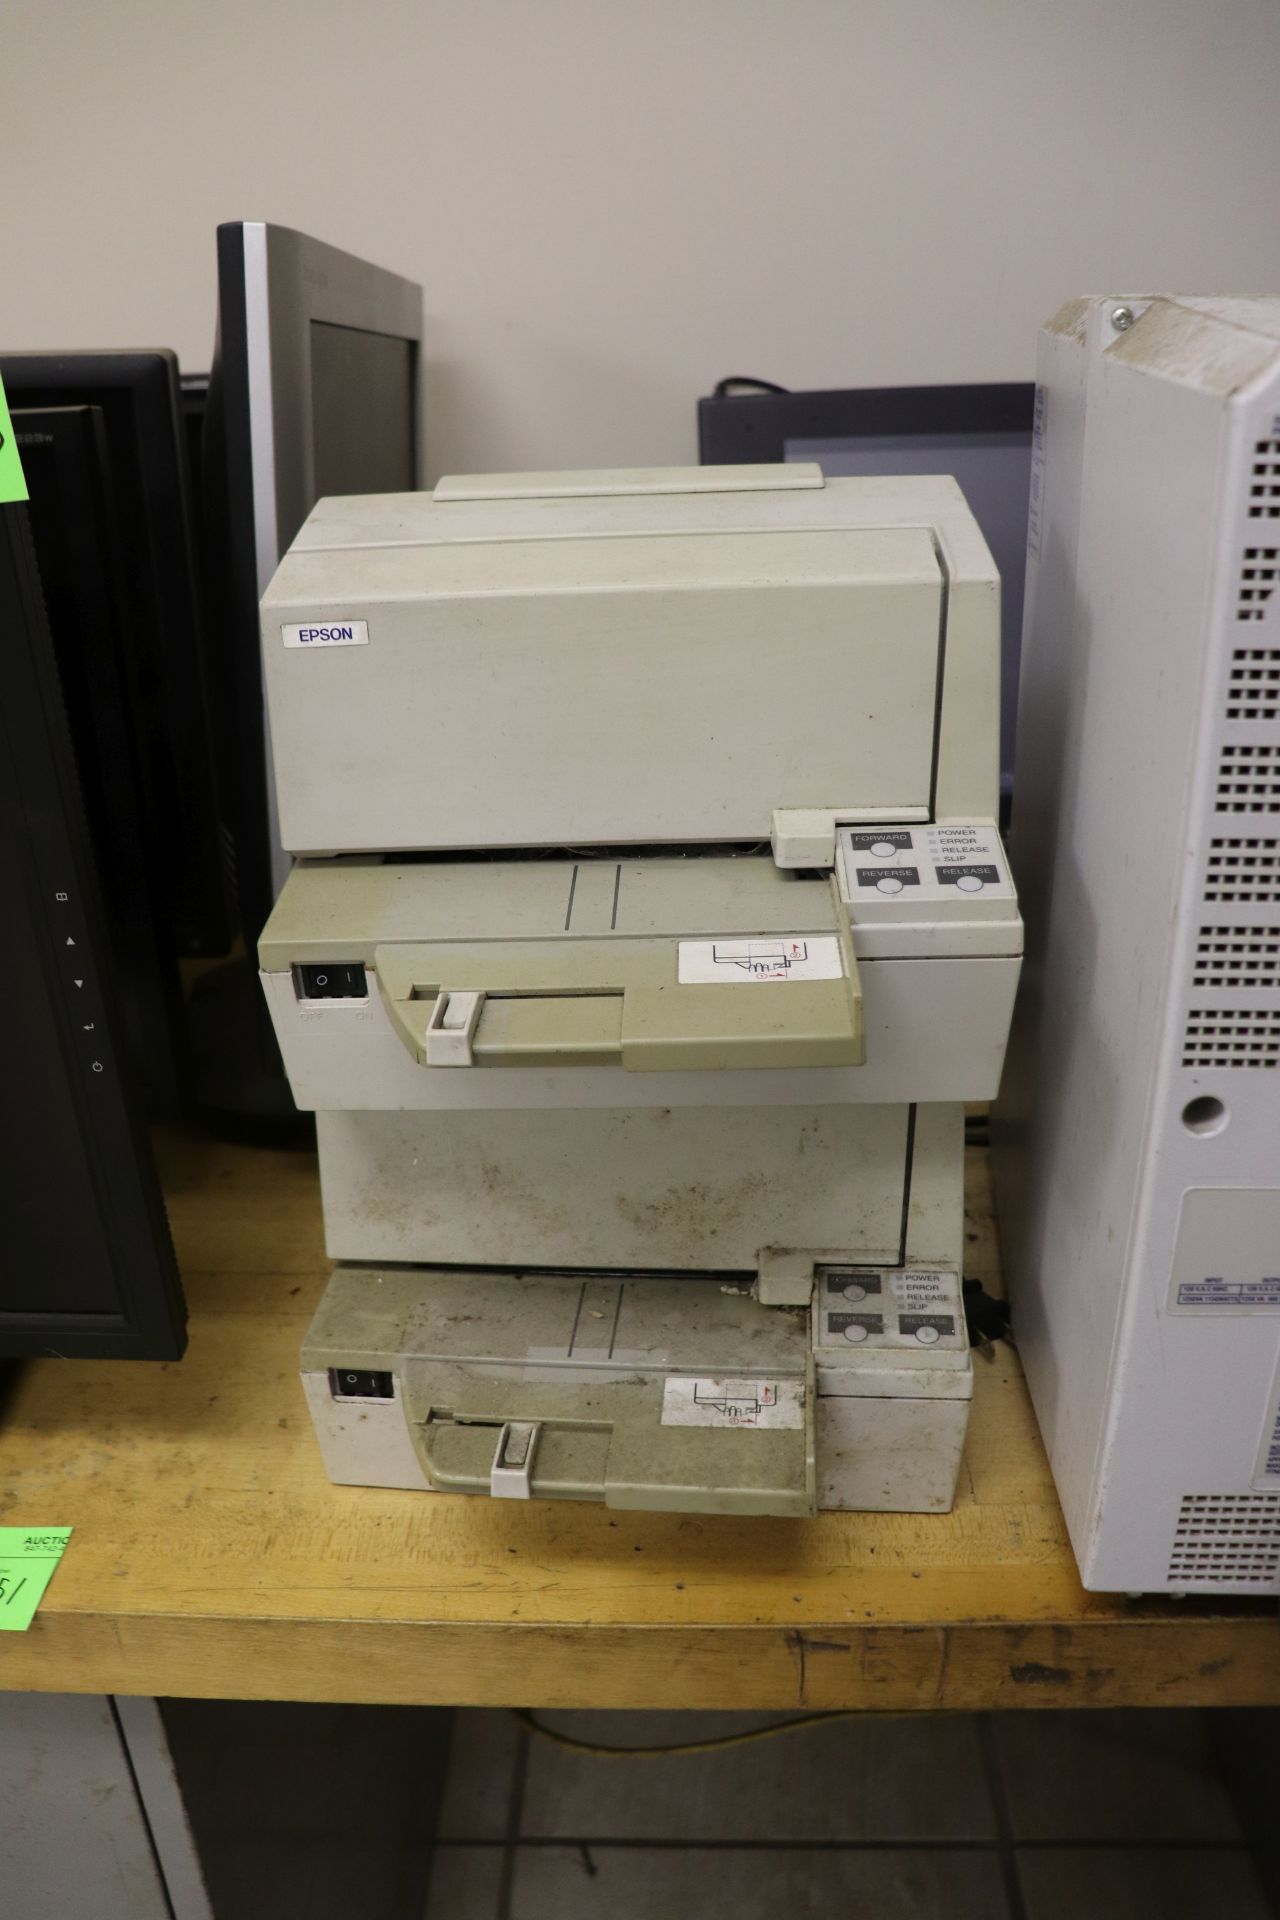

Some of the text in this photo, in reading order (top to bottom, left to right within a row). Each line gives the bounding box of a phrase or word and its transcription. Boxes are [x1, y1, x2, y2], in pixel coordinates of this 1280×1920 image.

[298, 627, 353, 642] EPSON
[855, 834, 907, 842] FORWARD
[942, 867, 991, 875] RELEASE
[905, 1274, 940, 1282] POWER
[906, 1293, 950, 1301] RELEASE
[907, 1303, 928, 1311] SLIP
[832, 1316, 880, 1324] REVERSE
[904, 1317, 948, 1325] RELEASE
